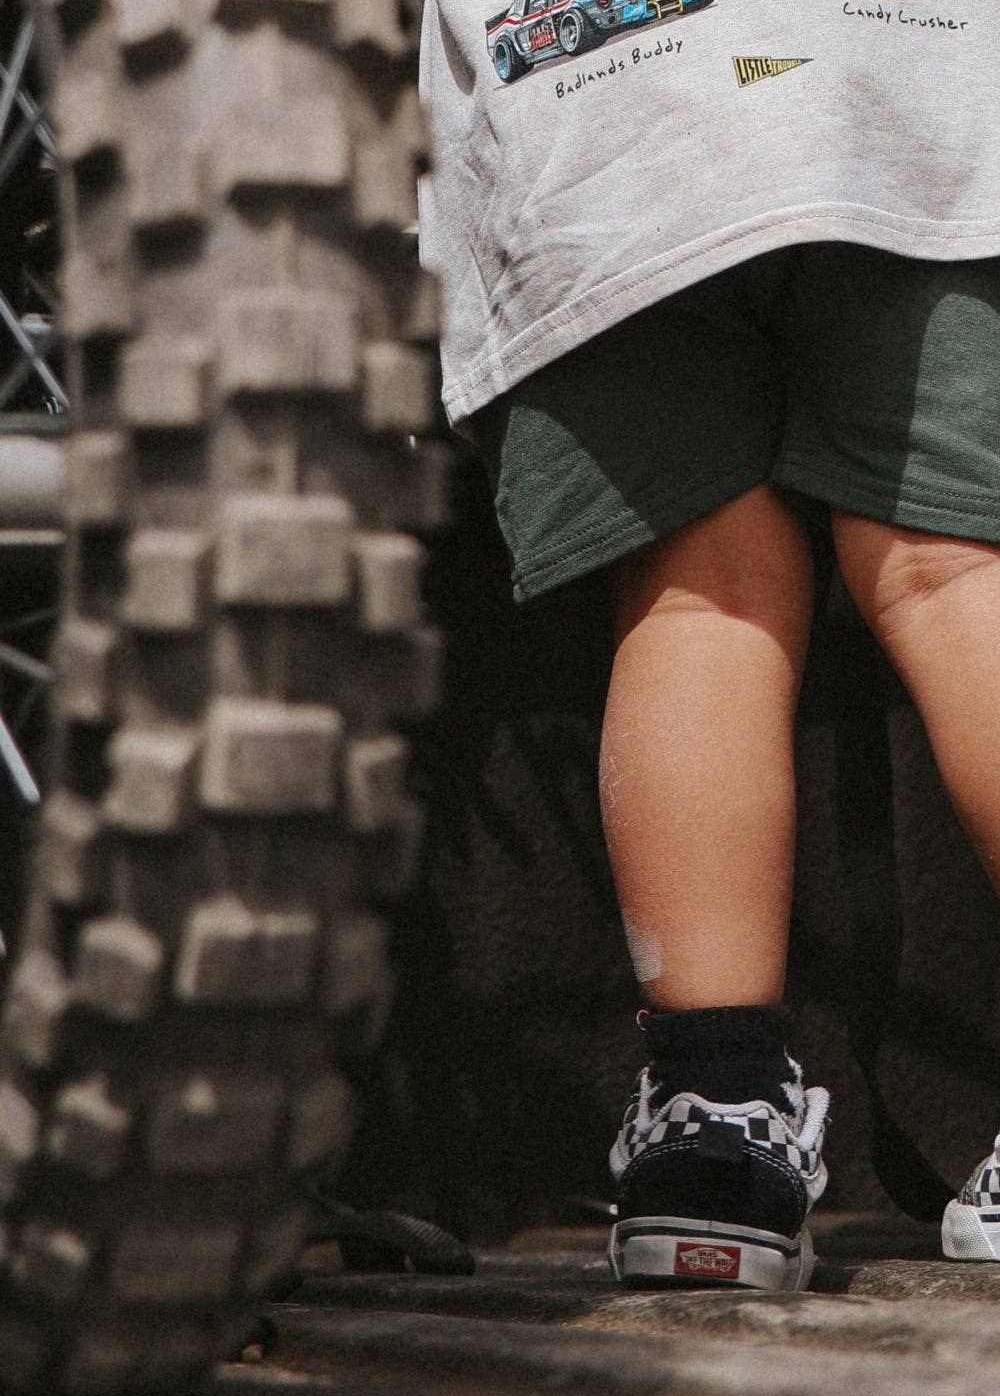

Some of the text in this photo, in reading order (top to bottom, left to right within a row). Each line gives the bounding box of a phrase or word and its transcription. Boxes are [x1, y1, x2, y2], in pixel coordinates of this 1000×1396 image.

[842, 2, 970, 31] Candy Crusher
[555, 37, 684, 99] Badlands Buddy
